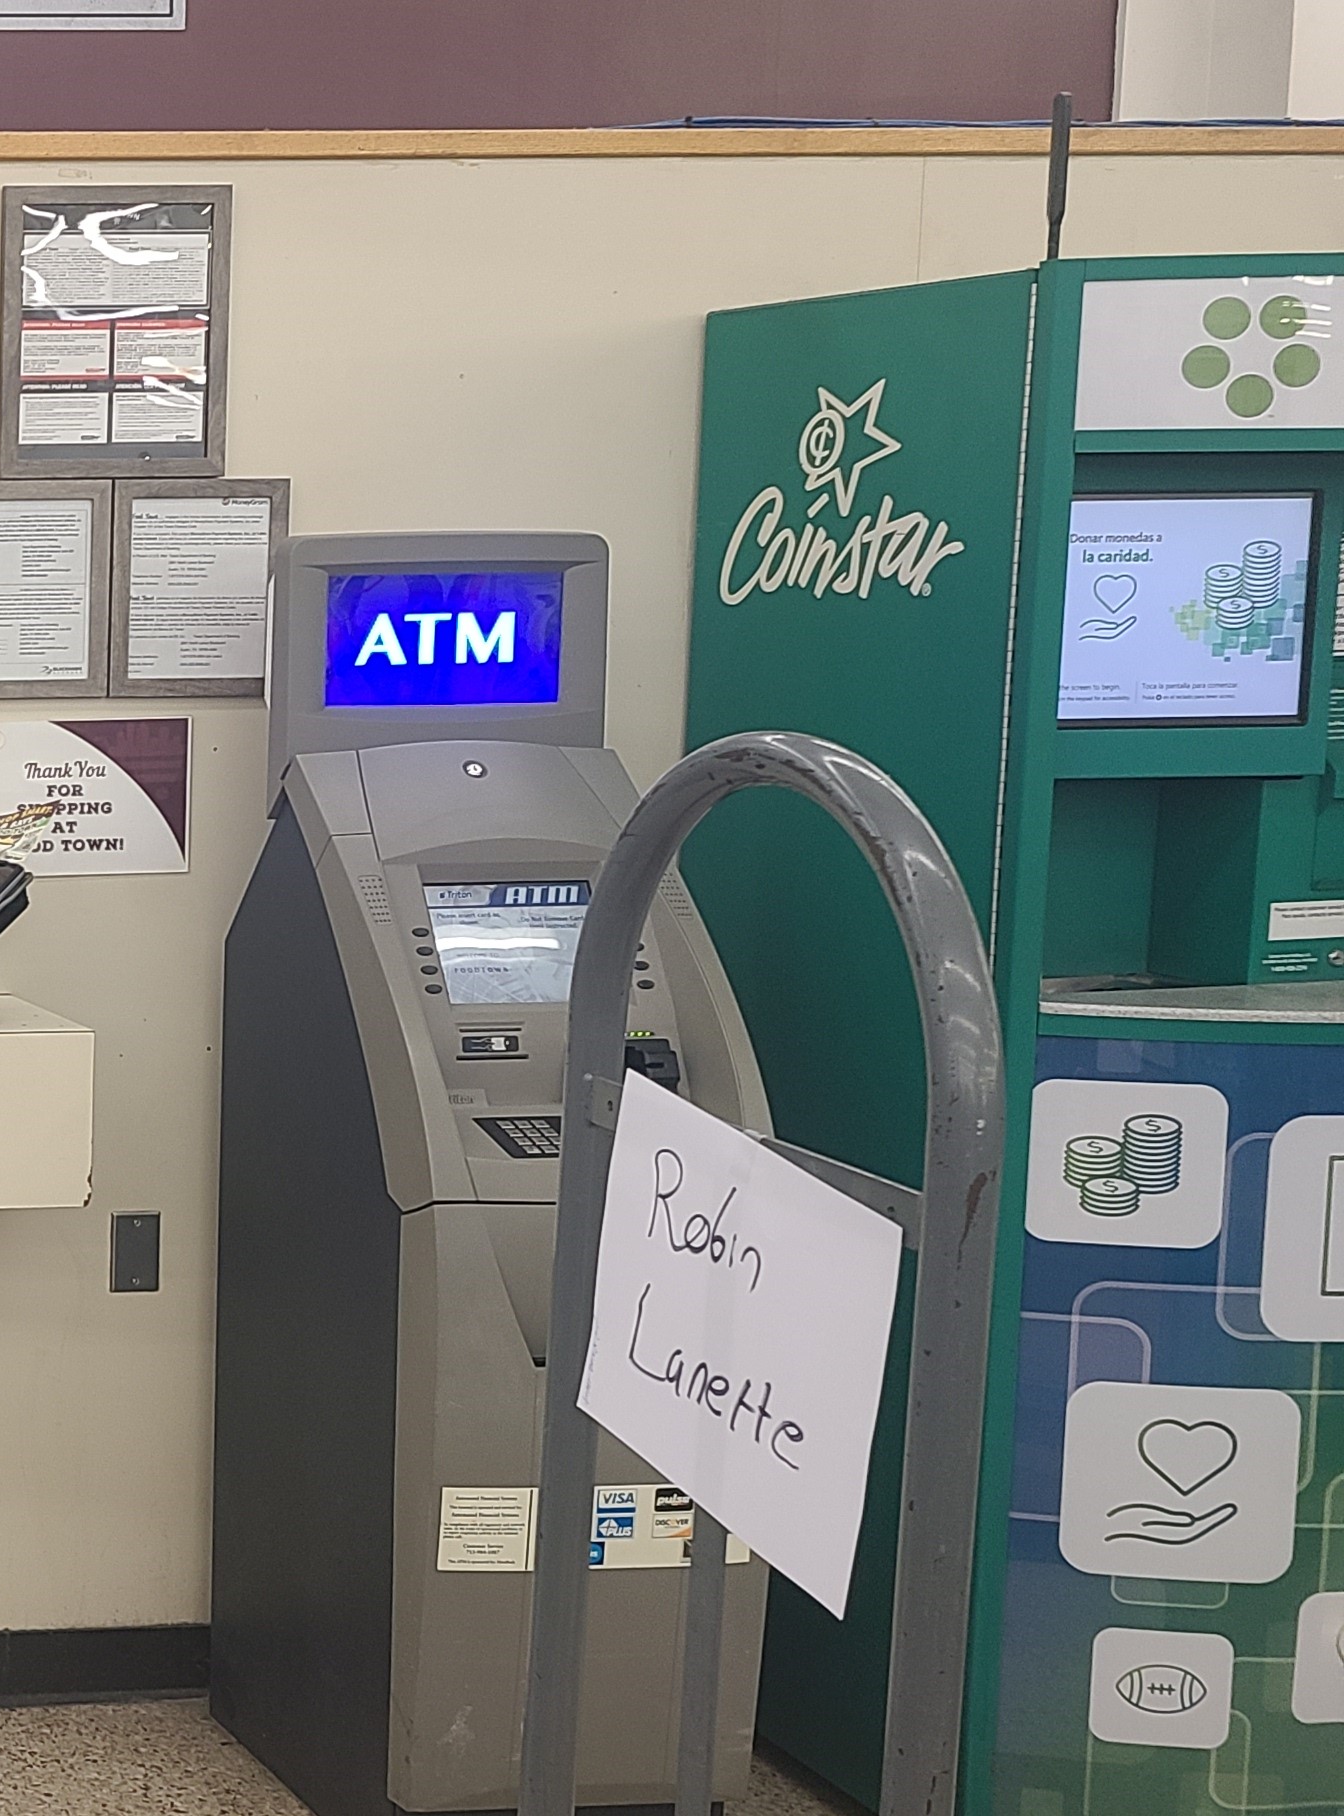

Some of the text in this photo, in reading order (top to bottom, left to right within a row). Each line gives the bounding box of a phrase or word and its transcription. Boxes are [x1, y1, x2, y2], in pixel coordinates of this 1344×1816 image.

[1070, 534, 1103, 544] Donar
[1105, 532, 1154, 543] monedas
[1082, 548, 1154, 563] la caridad.
[354, 611, 516, 666] ATM
[24, 760, 107, 779] Thank You
[46, 784, 84, 797] FOR
[17, 801, 112, 815] SPPING
[50, 821, 78, 834] AT
[61, 838, 124, 851] TOWN!
[447, 885, 579, 905] Triton ATM
[648, 1149, 761, 1292] Robin
[629, 1283, 804, 1470] Lanette
[603, 1492, 634, 1504] VISA
[657, 1493, 690, 1506] pulse
[607, 1526, 632, 1536] PLUS
